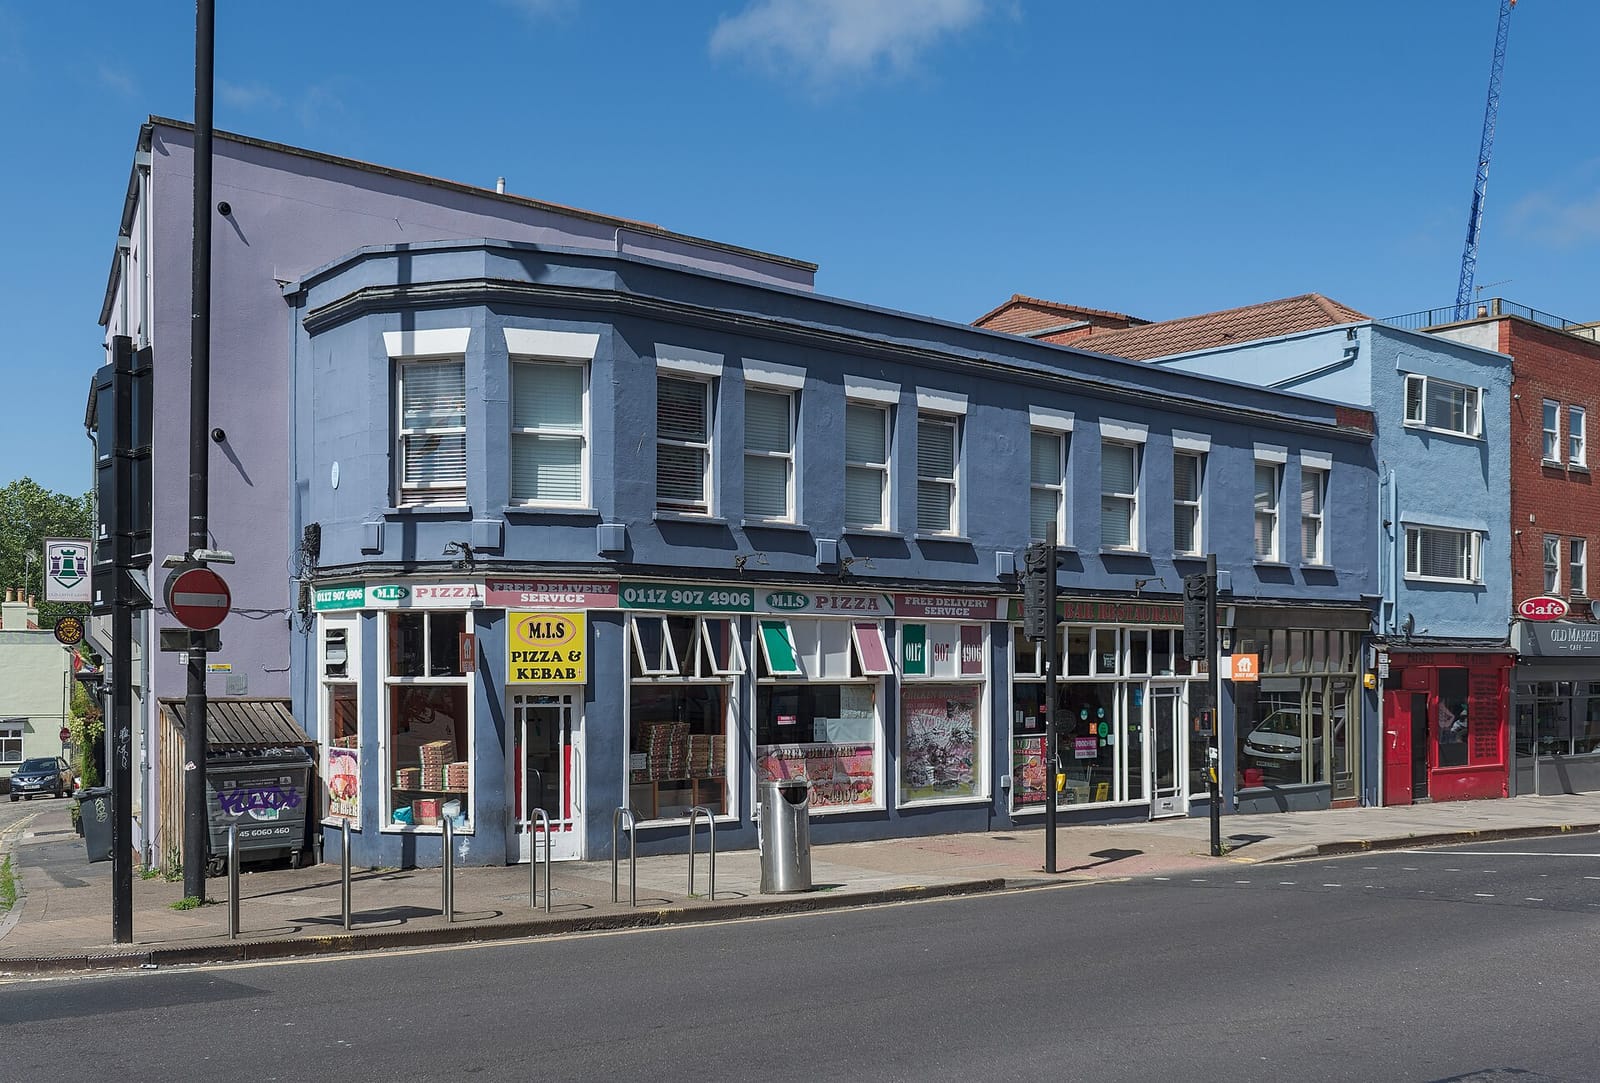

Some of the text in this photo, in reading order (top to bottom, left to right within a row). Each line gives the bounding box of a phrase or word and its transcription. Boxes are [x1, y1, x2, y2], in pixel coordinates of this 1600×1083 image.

[376, 588, 405, 599] M.I.S
[415, 587, 478, 598] PIZZA
[493, 582, 611, 593] FREE DELIVERY
[317, 589, 363, 601] 0117 907 4906
[521, 593, 585, 603] SERVICE
[624, 588, 750, 606] 0117 907 4906
[771, 594, 805, 607] M.I.S
[815, 596, 879, 610] PIZZA
[905, 597, 988, 608] FREE DELIVERY
[924, 606, 970, 616] SERVICE
[1064, 602, 1185, 623] BAR RESTAURAN
[529, 622, 565, 639] M.I.S
[1551, 628, 1600, 642] OLD MARKET
[511, 650, 582, 662] PIZZA &
[905, 642, 982, 662] 0117 907 4906
[517, 668, 577, 679] KEBAB
